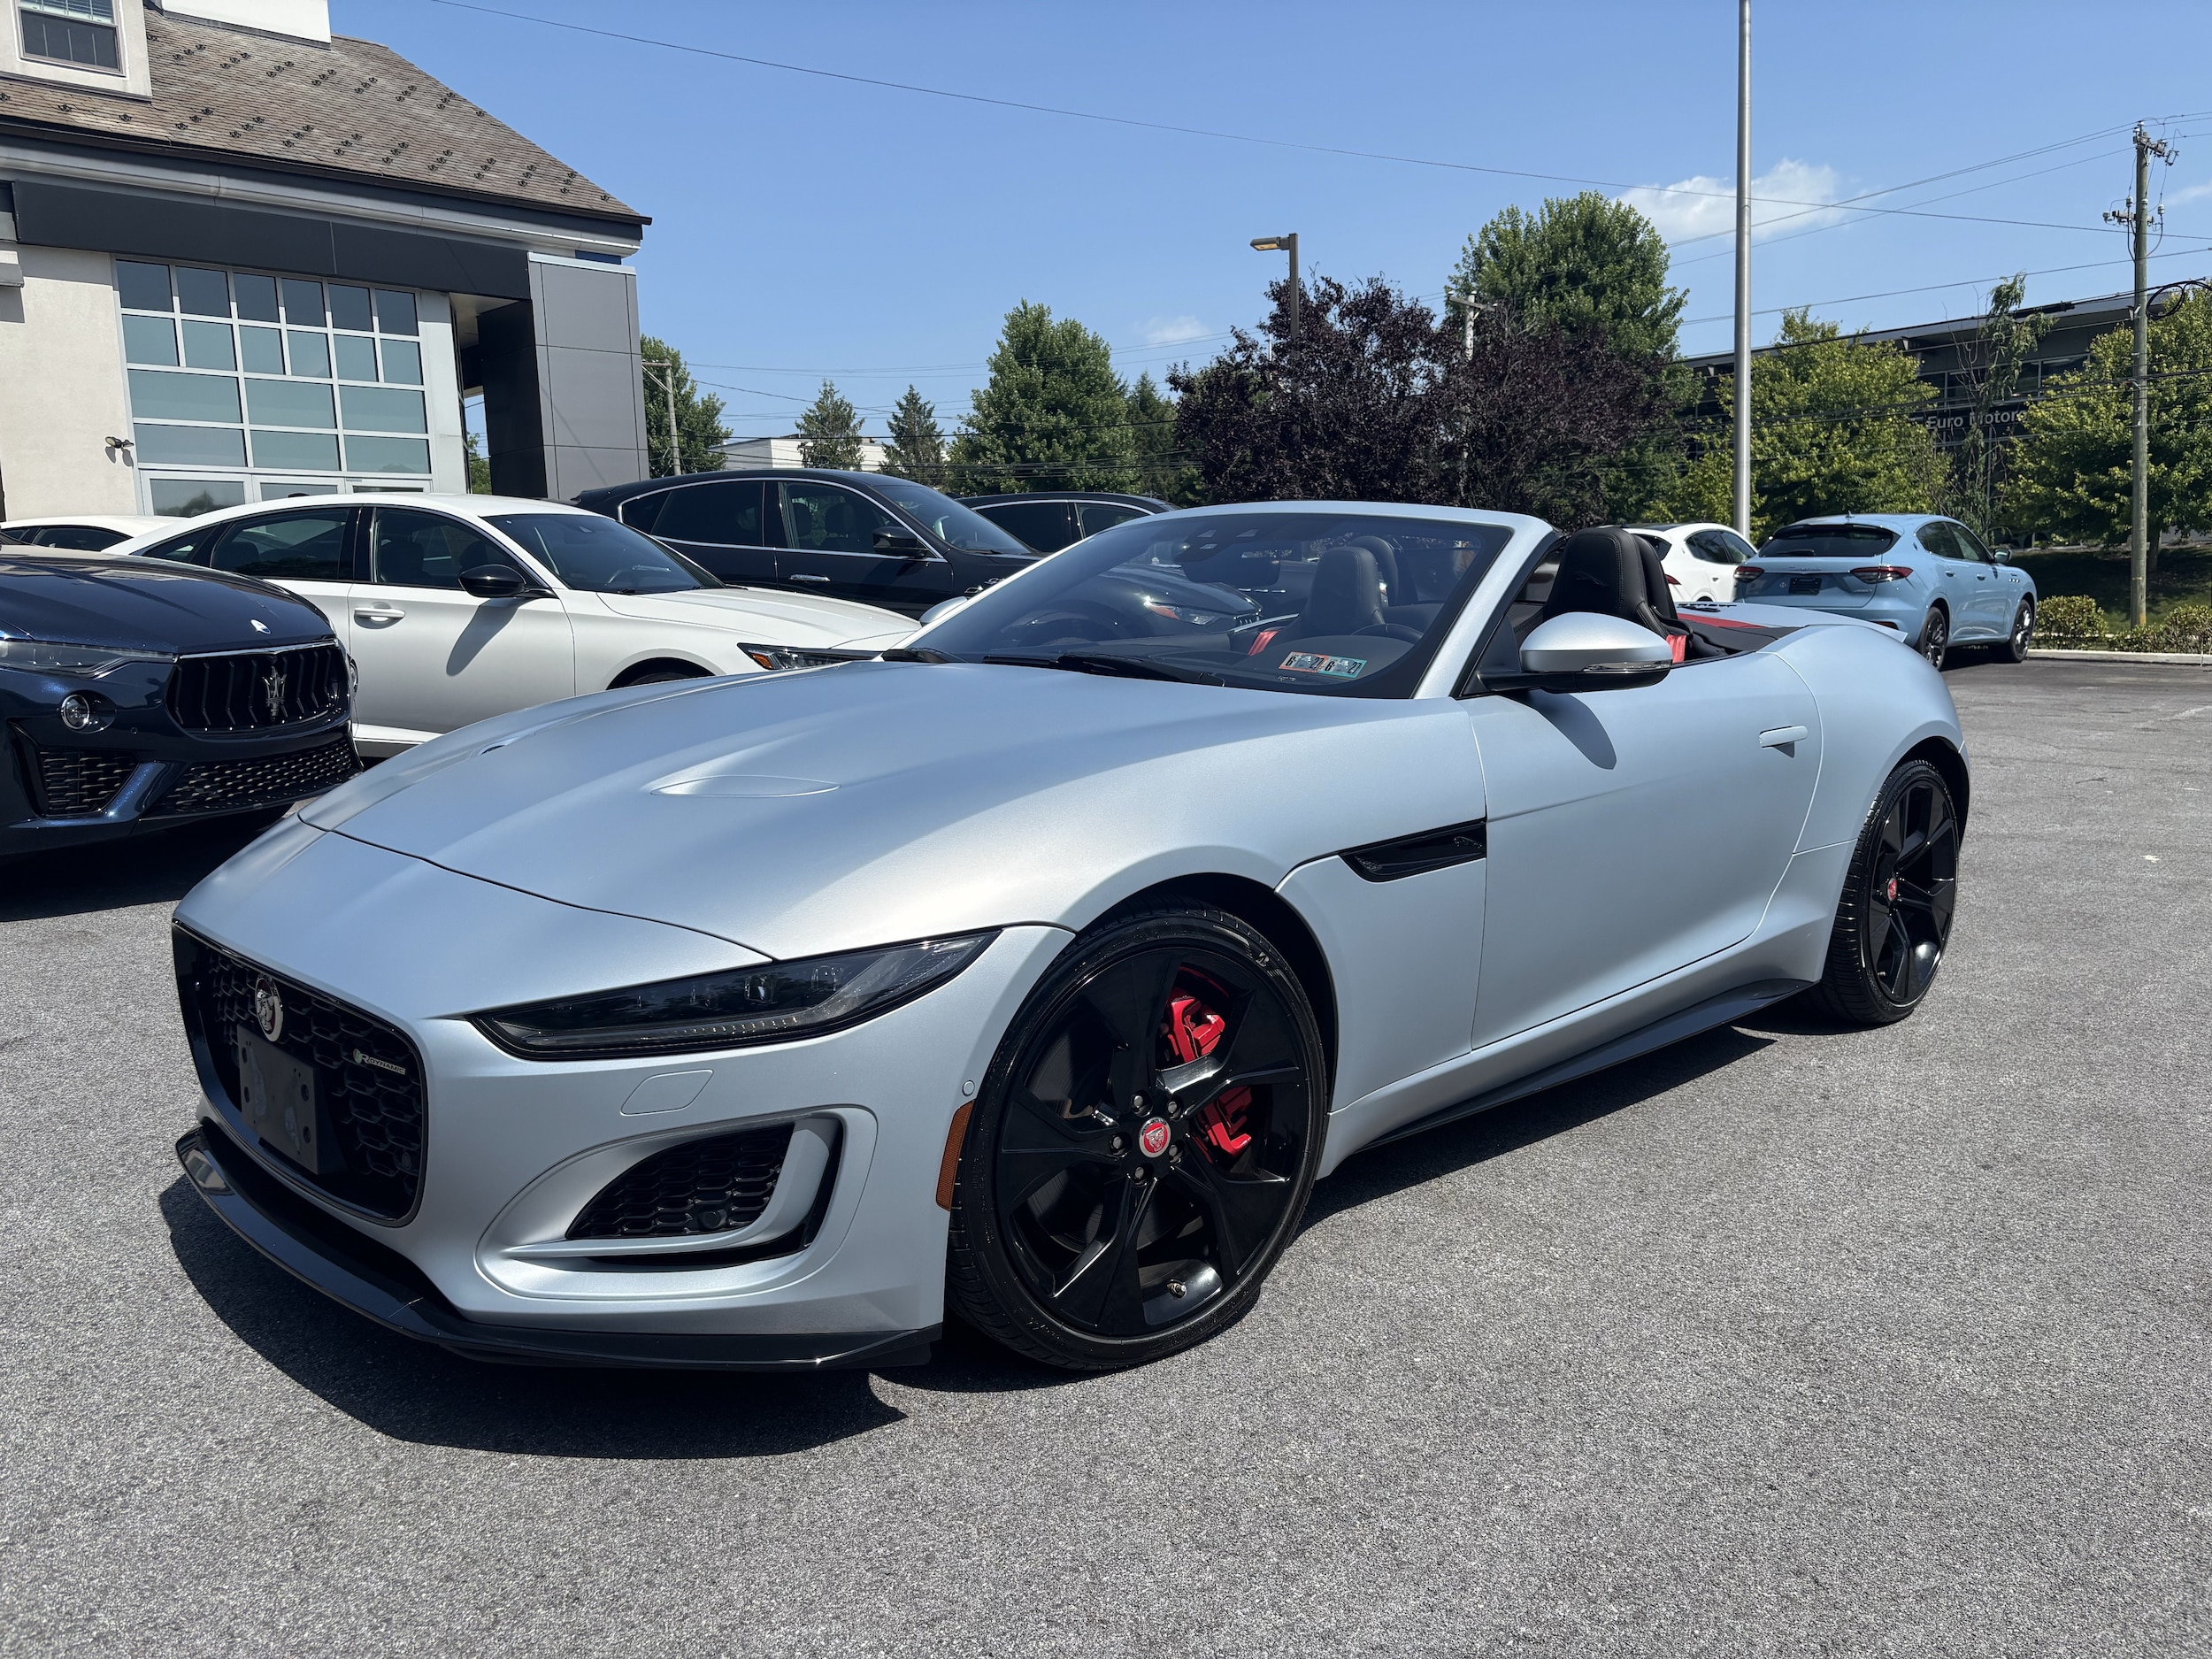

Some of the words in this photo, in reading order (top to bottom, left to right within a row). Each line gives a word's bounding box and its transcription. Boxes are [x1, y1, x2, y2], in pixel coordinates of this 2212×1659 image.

[1926, 416, 1963, 430] Euro
[1310, 657, 1325, 670] 27
[1348, 662, 1363, 674] 27
